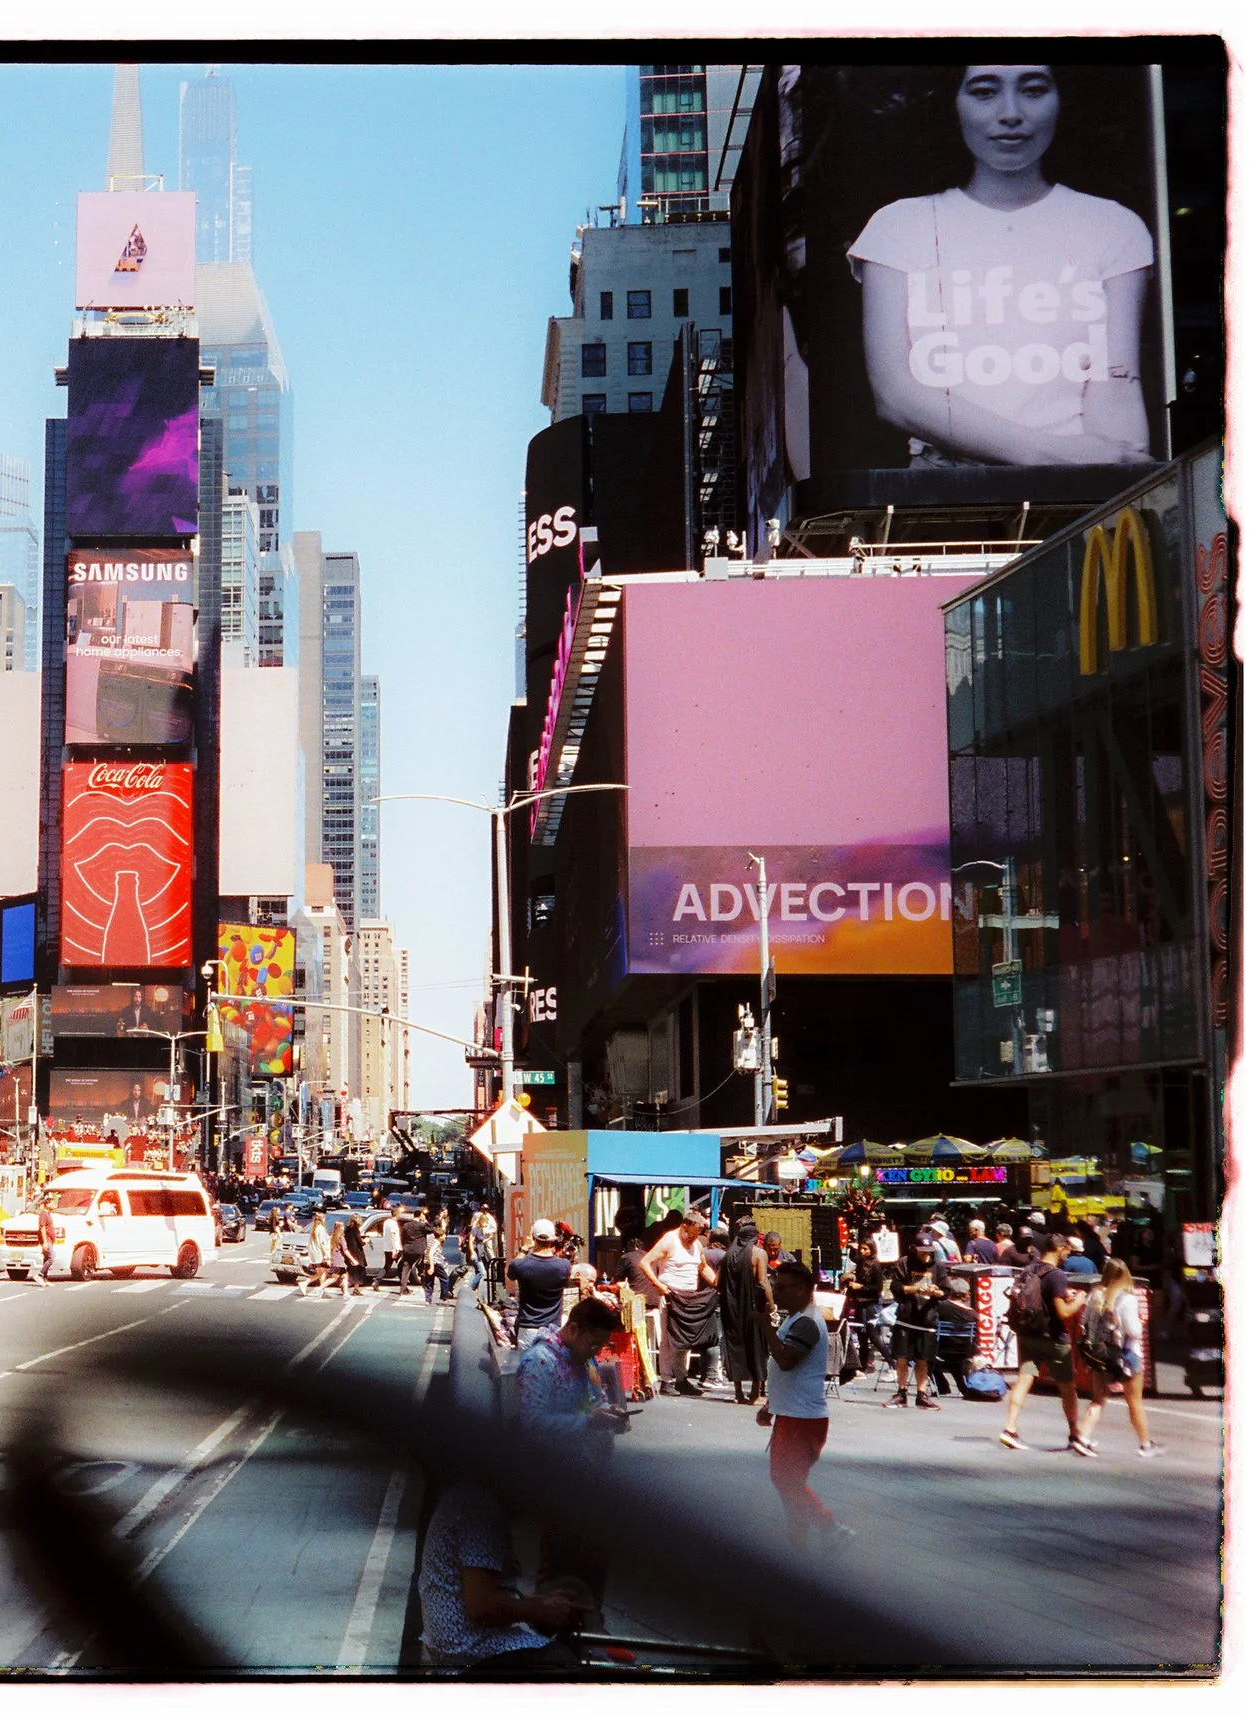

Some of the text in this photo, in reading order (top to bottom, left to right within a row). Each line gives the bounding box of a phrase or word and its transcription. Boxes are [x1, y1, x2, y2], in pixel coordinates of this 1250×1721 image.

[907, 265, 1108, 328] Life's
[909, 325, 1108, 388] Good
[73, 563, 188, 581] SAMSUNG
[101, 634, 158, 645] our latest
[76, 647, 111, 657] home
[88, 763, 164, 789] Coca-Cola
[672, 882, 974, 921] ADVECTION
[673, 934, 716, 944] RELATIVE
[721, 934, 760, 944] DENSITY
[523, 1073, 531, 1083] W
[534, 1073, 544, 1083] 45
[251, 1139, 264, 1164] tkts
[909, 1169, 955, 1182] GYRO
